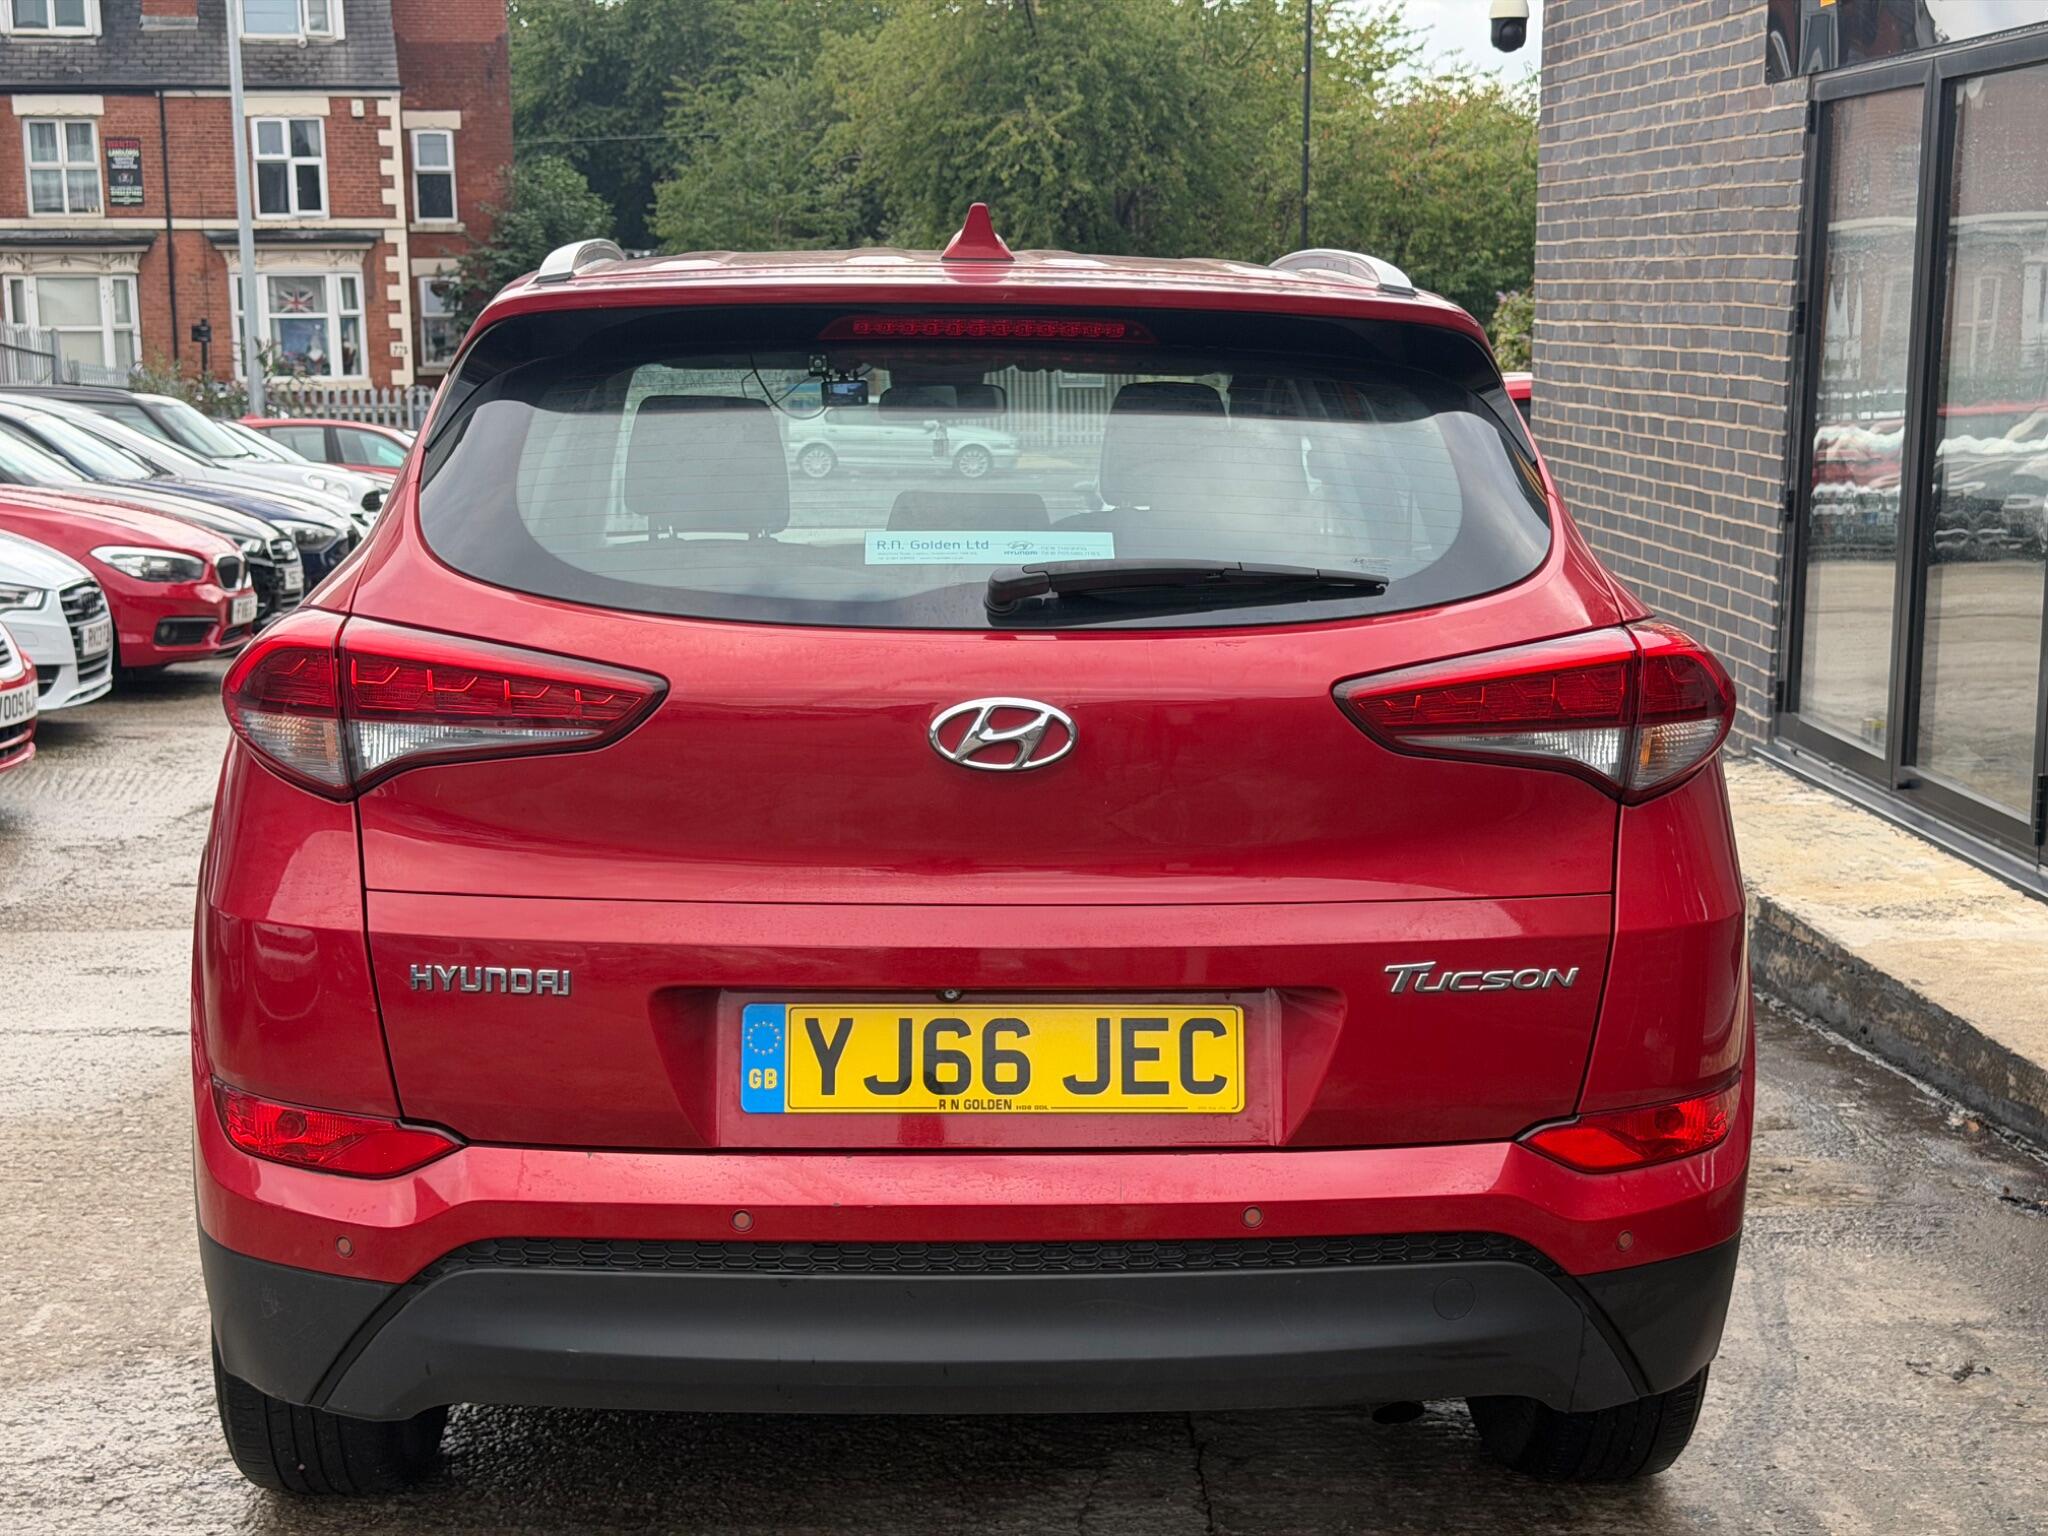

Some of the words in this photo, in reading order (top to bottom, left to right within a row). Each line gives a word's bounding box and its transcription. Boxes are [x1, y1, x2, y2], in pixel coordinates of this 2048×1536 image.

[910, 539, 961, 550] Golden
[966, 539, 990, 550] Ltd
[410, 964, 570, 996] HYUNDAI
[1384, 960, 1580, 993] TUCSON
[803, 1017, 1031, 1096] YJ66
[1062, 1017, 1228, 1096] JEC
[748, 1068, 778, 1089] GB
[938, 1099, 946, 1110] R
[951, 1099, 960, 1110] N
[963, 1098, 1012, 1110] GOLDEN
